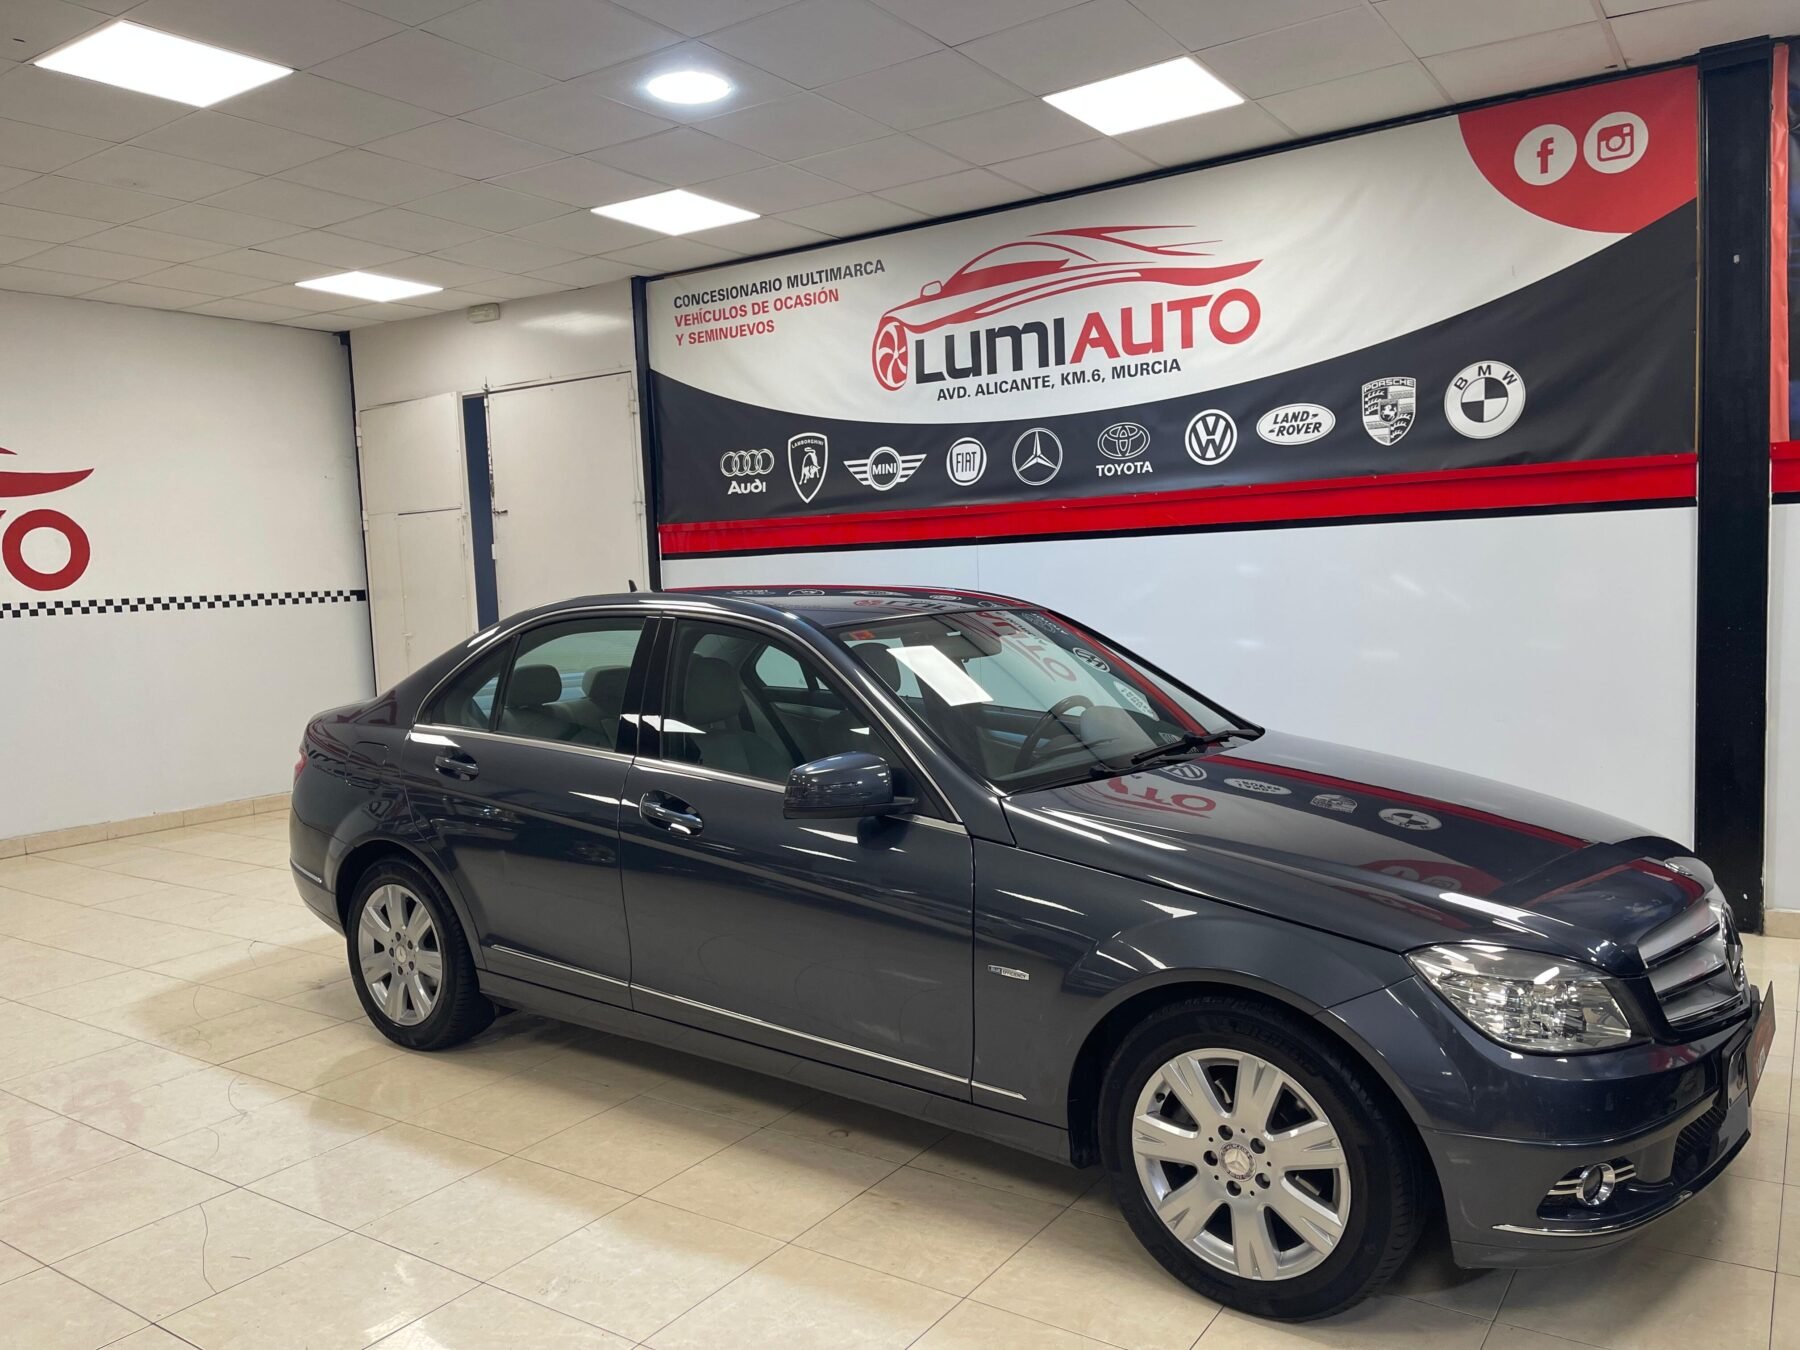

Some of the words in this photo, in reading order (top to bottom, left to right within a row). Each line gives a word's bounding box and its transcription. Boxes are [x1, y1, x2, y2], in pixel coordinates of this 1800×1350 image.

[674, 278, 783, 309] CONCESIONARIO
[786, 259, 886, 289] MULTIMARCA
[674, 304, 748, 328] VEHÍCULOS
[751, 300, 770, 316] DE
[773, 286, 840, 312] OCASIÓN
[675, 334, 685, 346] Y
[688, 319, 775, 345] SEMINUEVOS
[936, 386, 972, 401] AVD.
[974, 374, 1056, 398] ALICANTE,
[1061, 368, 1107, 387] KM.6,
[1111, 358, 1182, 380] MURCIA
[1363, 378, 1415, 393] PORSCHE
[872, 462, 897, 476] MINI
[955, 451, 978, 474] FIAT
[1096, 461, 1153, 477] TOYOTA
[727, 478, 767, 495] Audi
